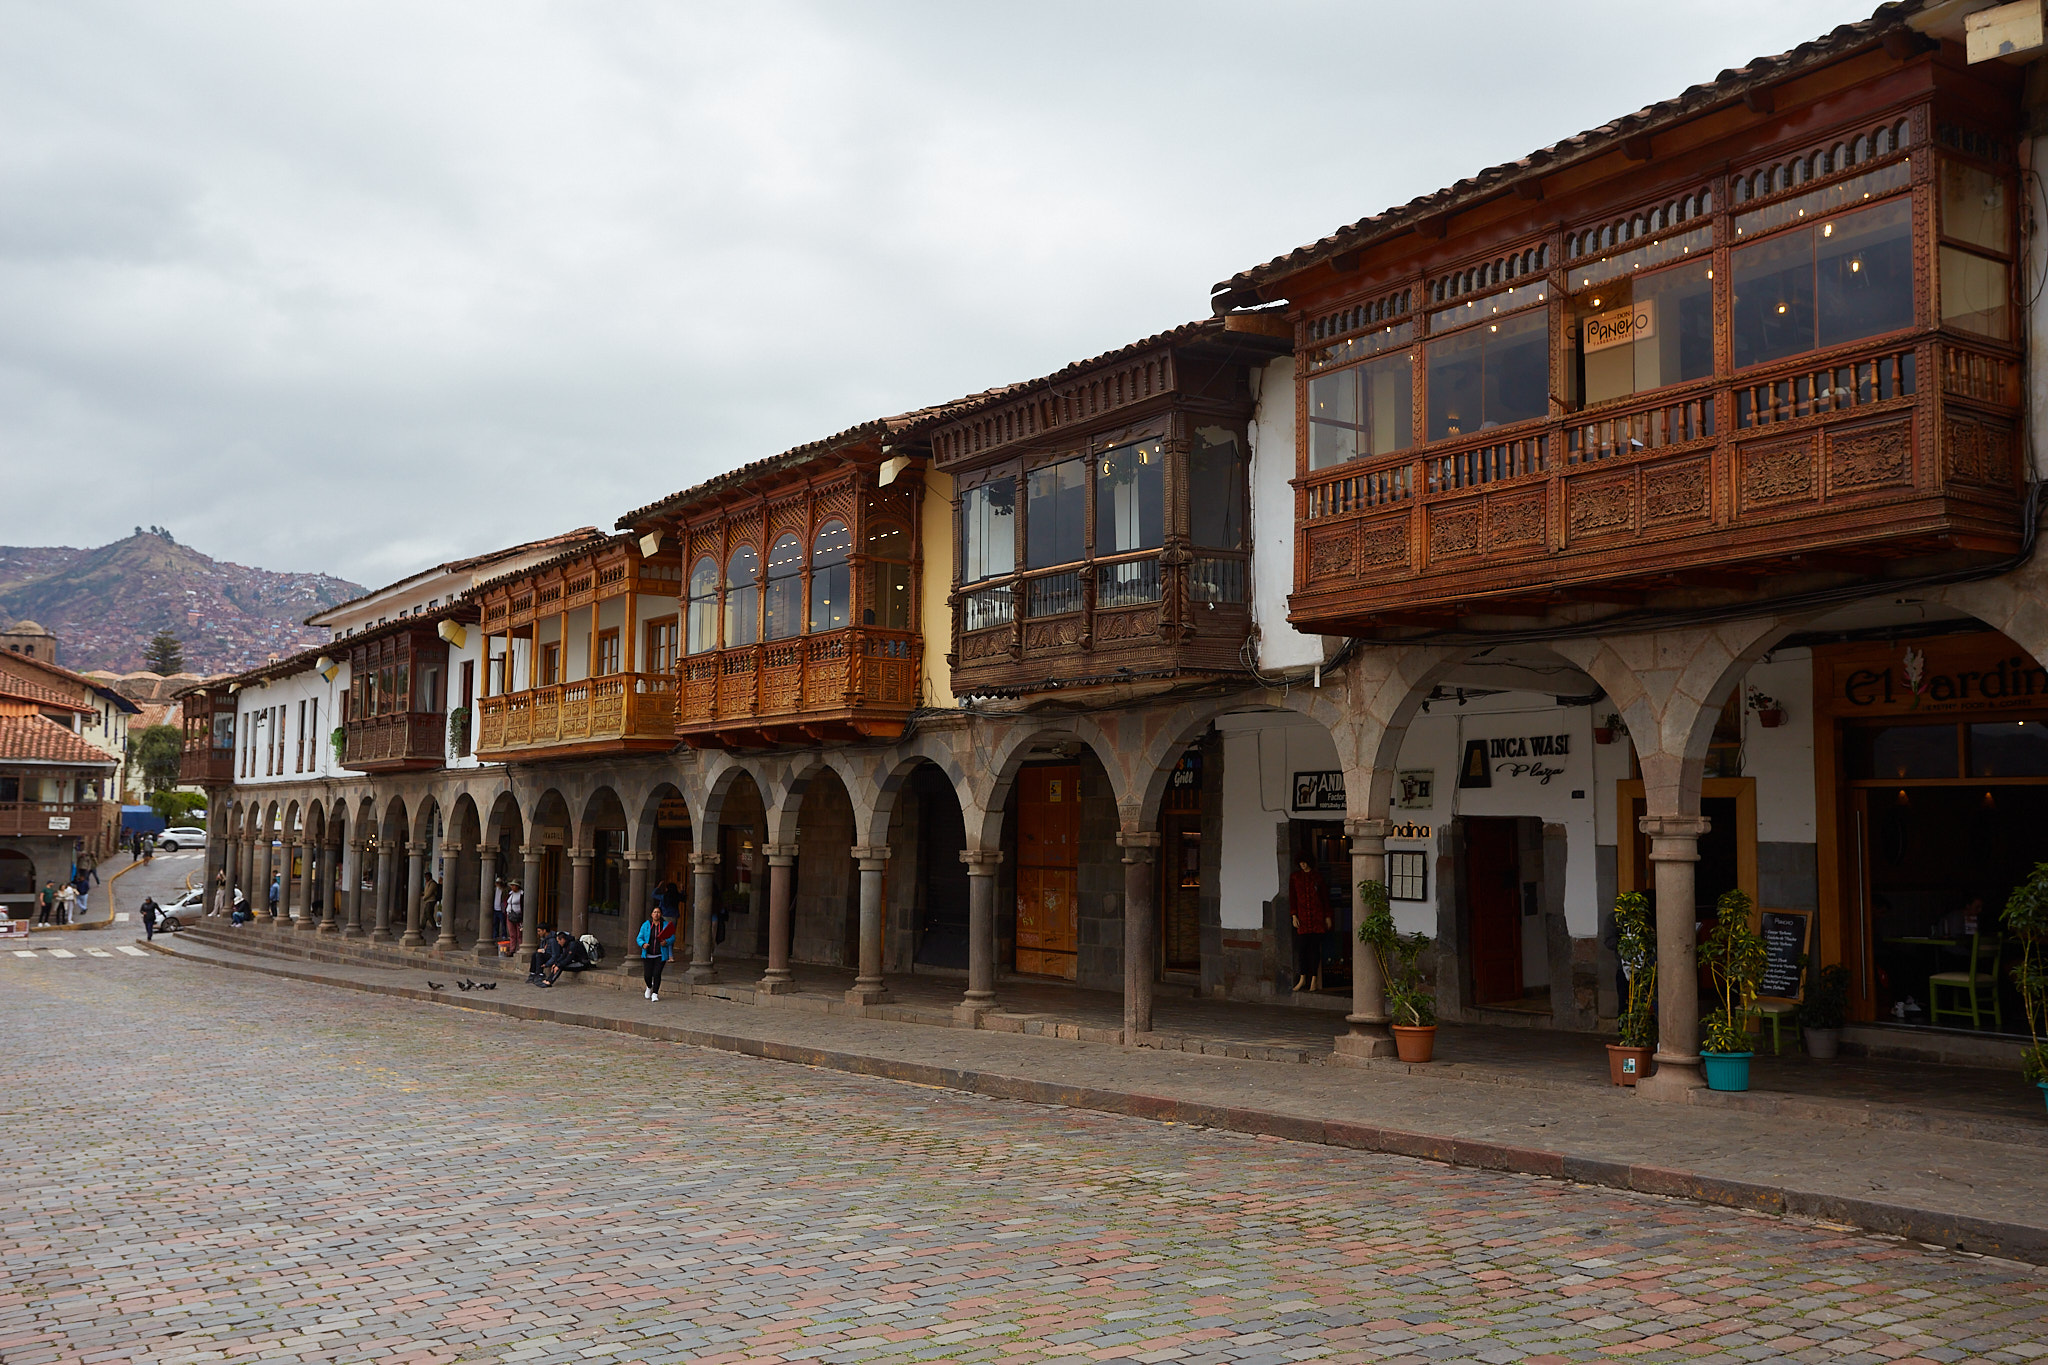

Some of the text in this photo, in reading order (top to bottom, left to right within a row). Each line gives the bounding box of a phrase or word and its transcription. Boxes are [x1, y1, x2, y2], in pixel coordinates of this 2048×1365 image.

[1617, 311, 1631, 320] DON
[1587, 314, 1648, 343] PANCHO
[1961, 701, 1985, 710] FOOD
[1490, 734, 1570, 759] INCA WASI
[1174, 771, 1193, 787] Grill
[1495, 761, 1565, 786] Plaza
